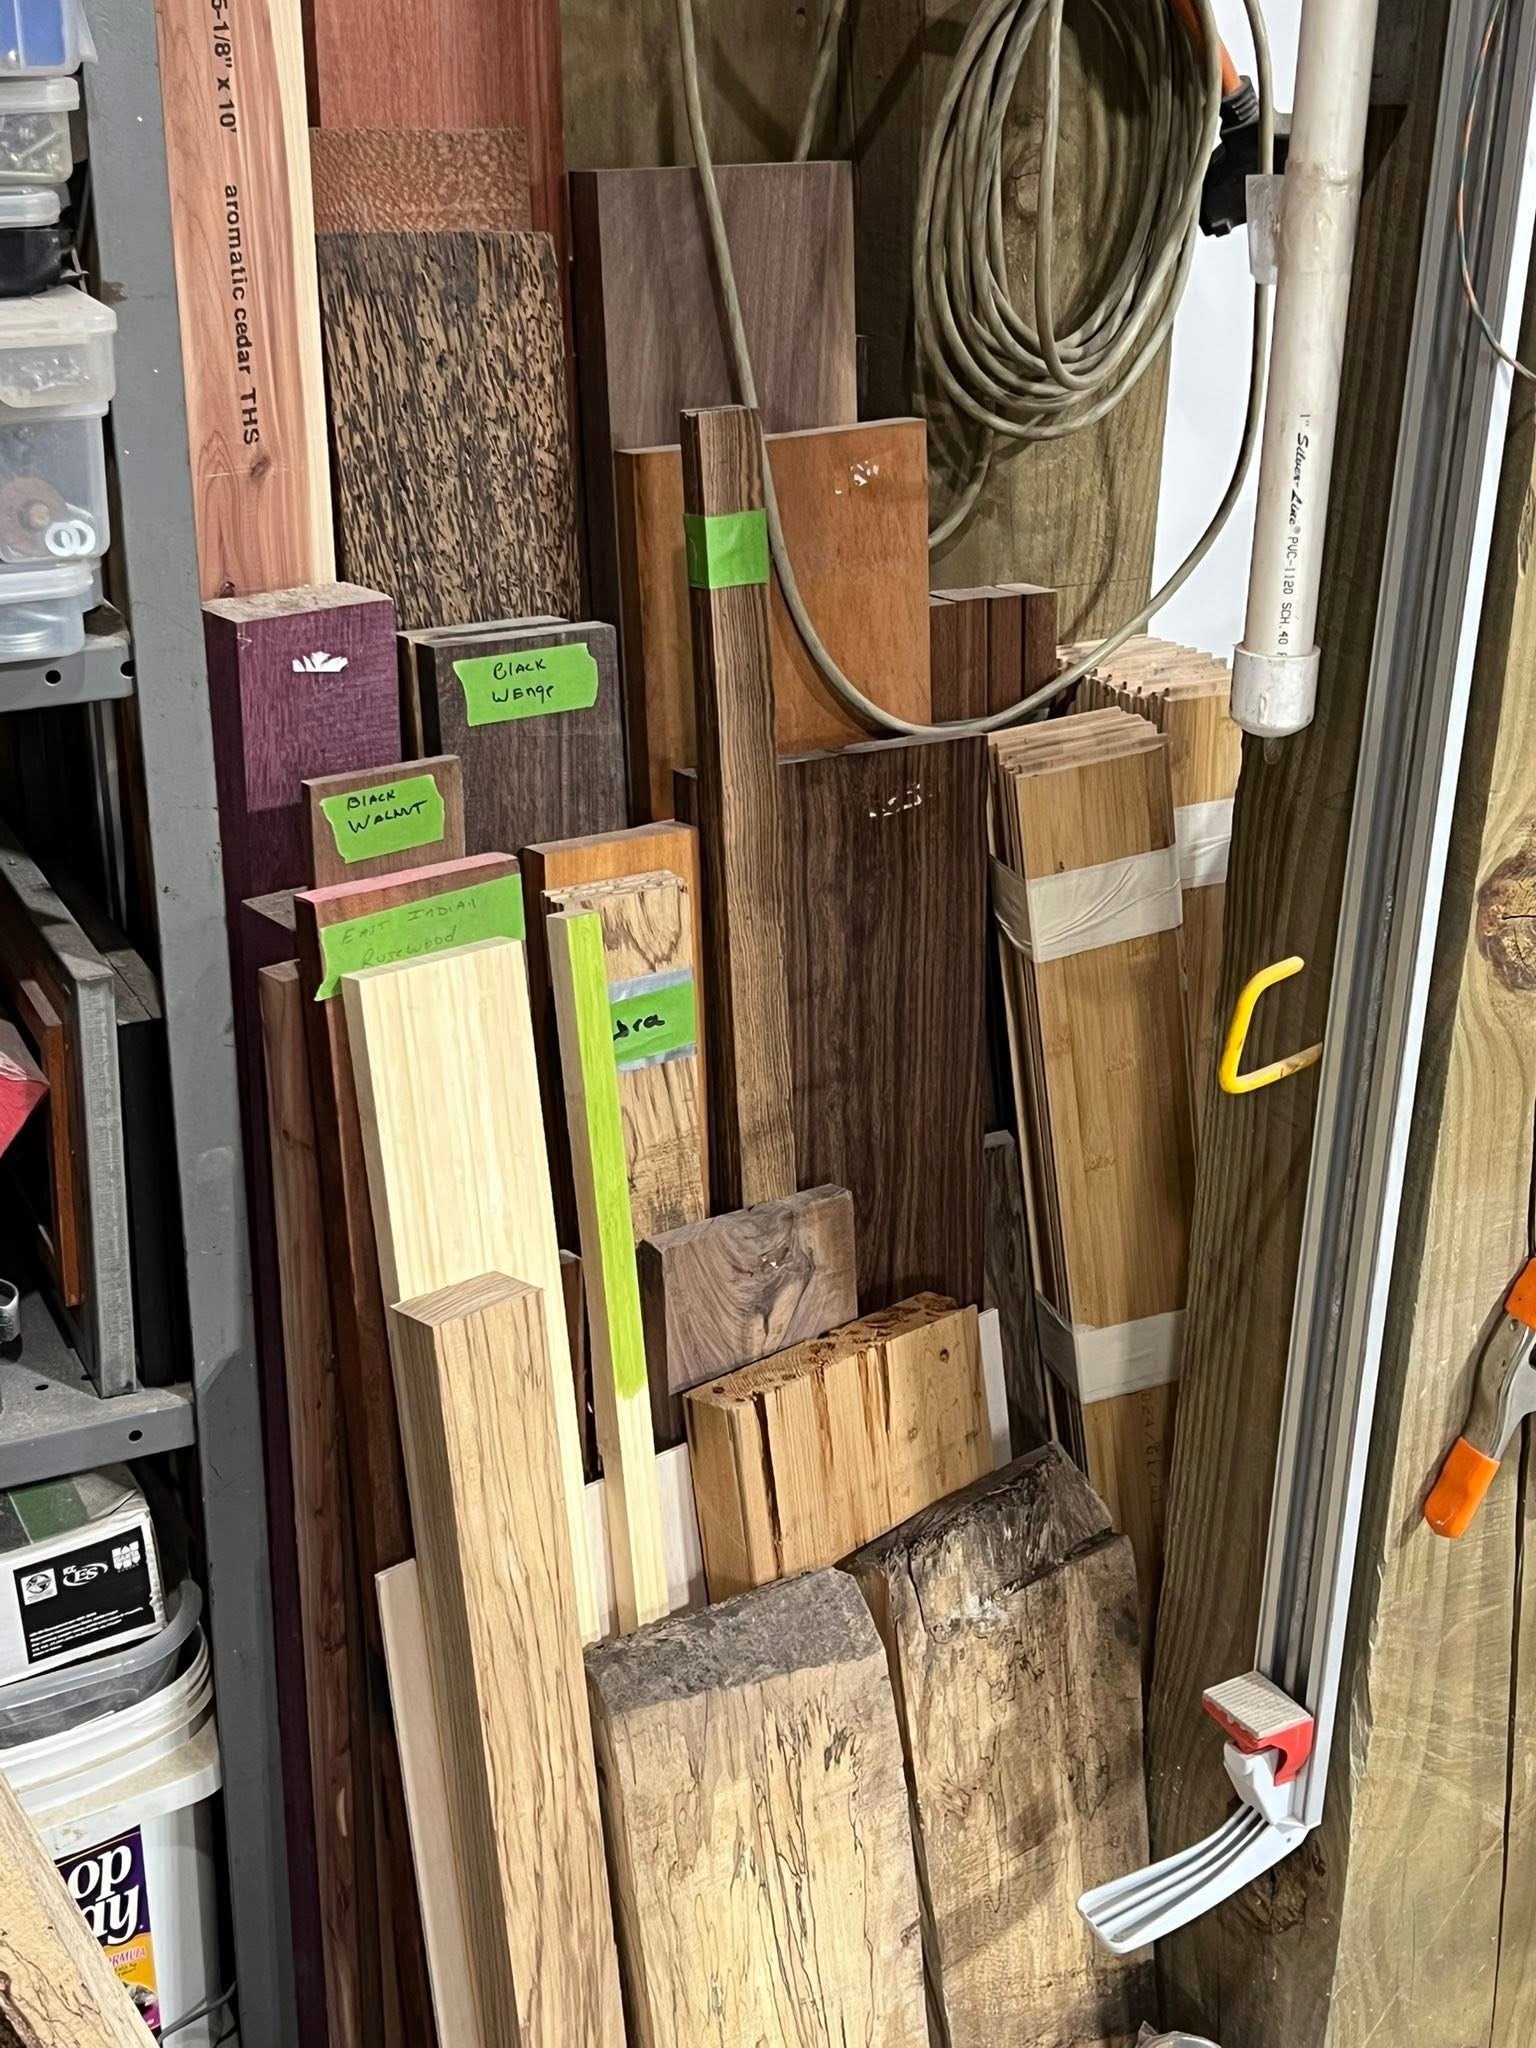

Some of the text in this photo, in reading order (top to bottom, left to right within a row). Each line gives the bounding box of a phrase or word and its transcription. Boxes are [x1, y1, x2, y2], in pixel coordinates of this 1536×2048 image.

[217, 77, 231, 91] x
[225, 185, 248, 301] aromatic
[234, 308, 253, 375] cedar
[240, 387, 260, 445] THS
